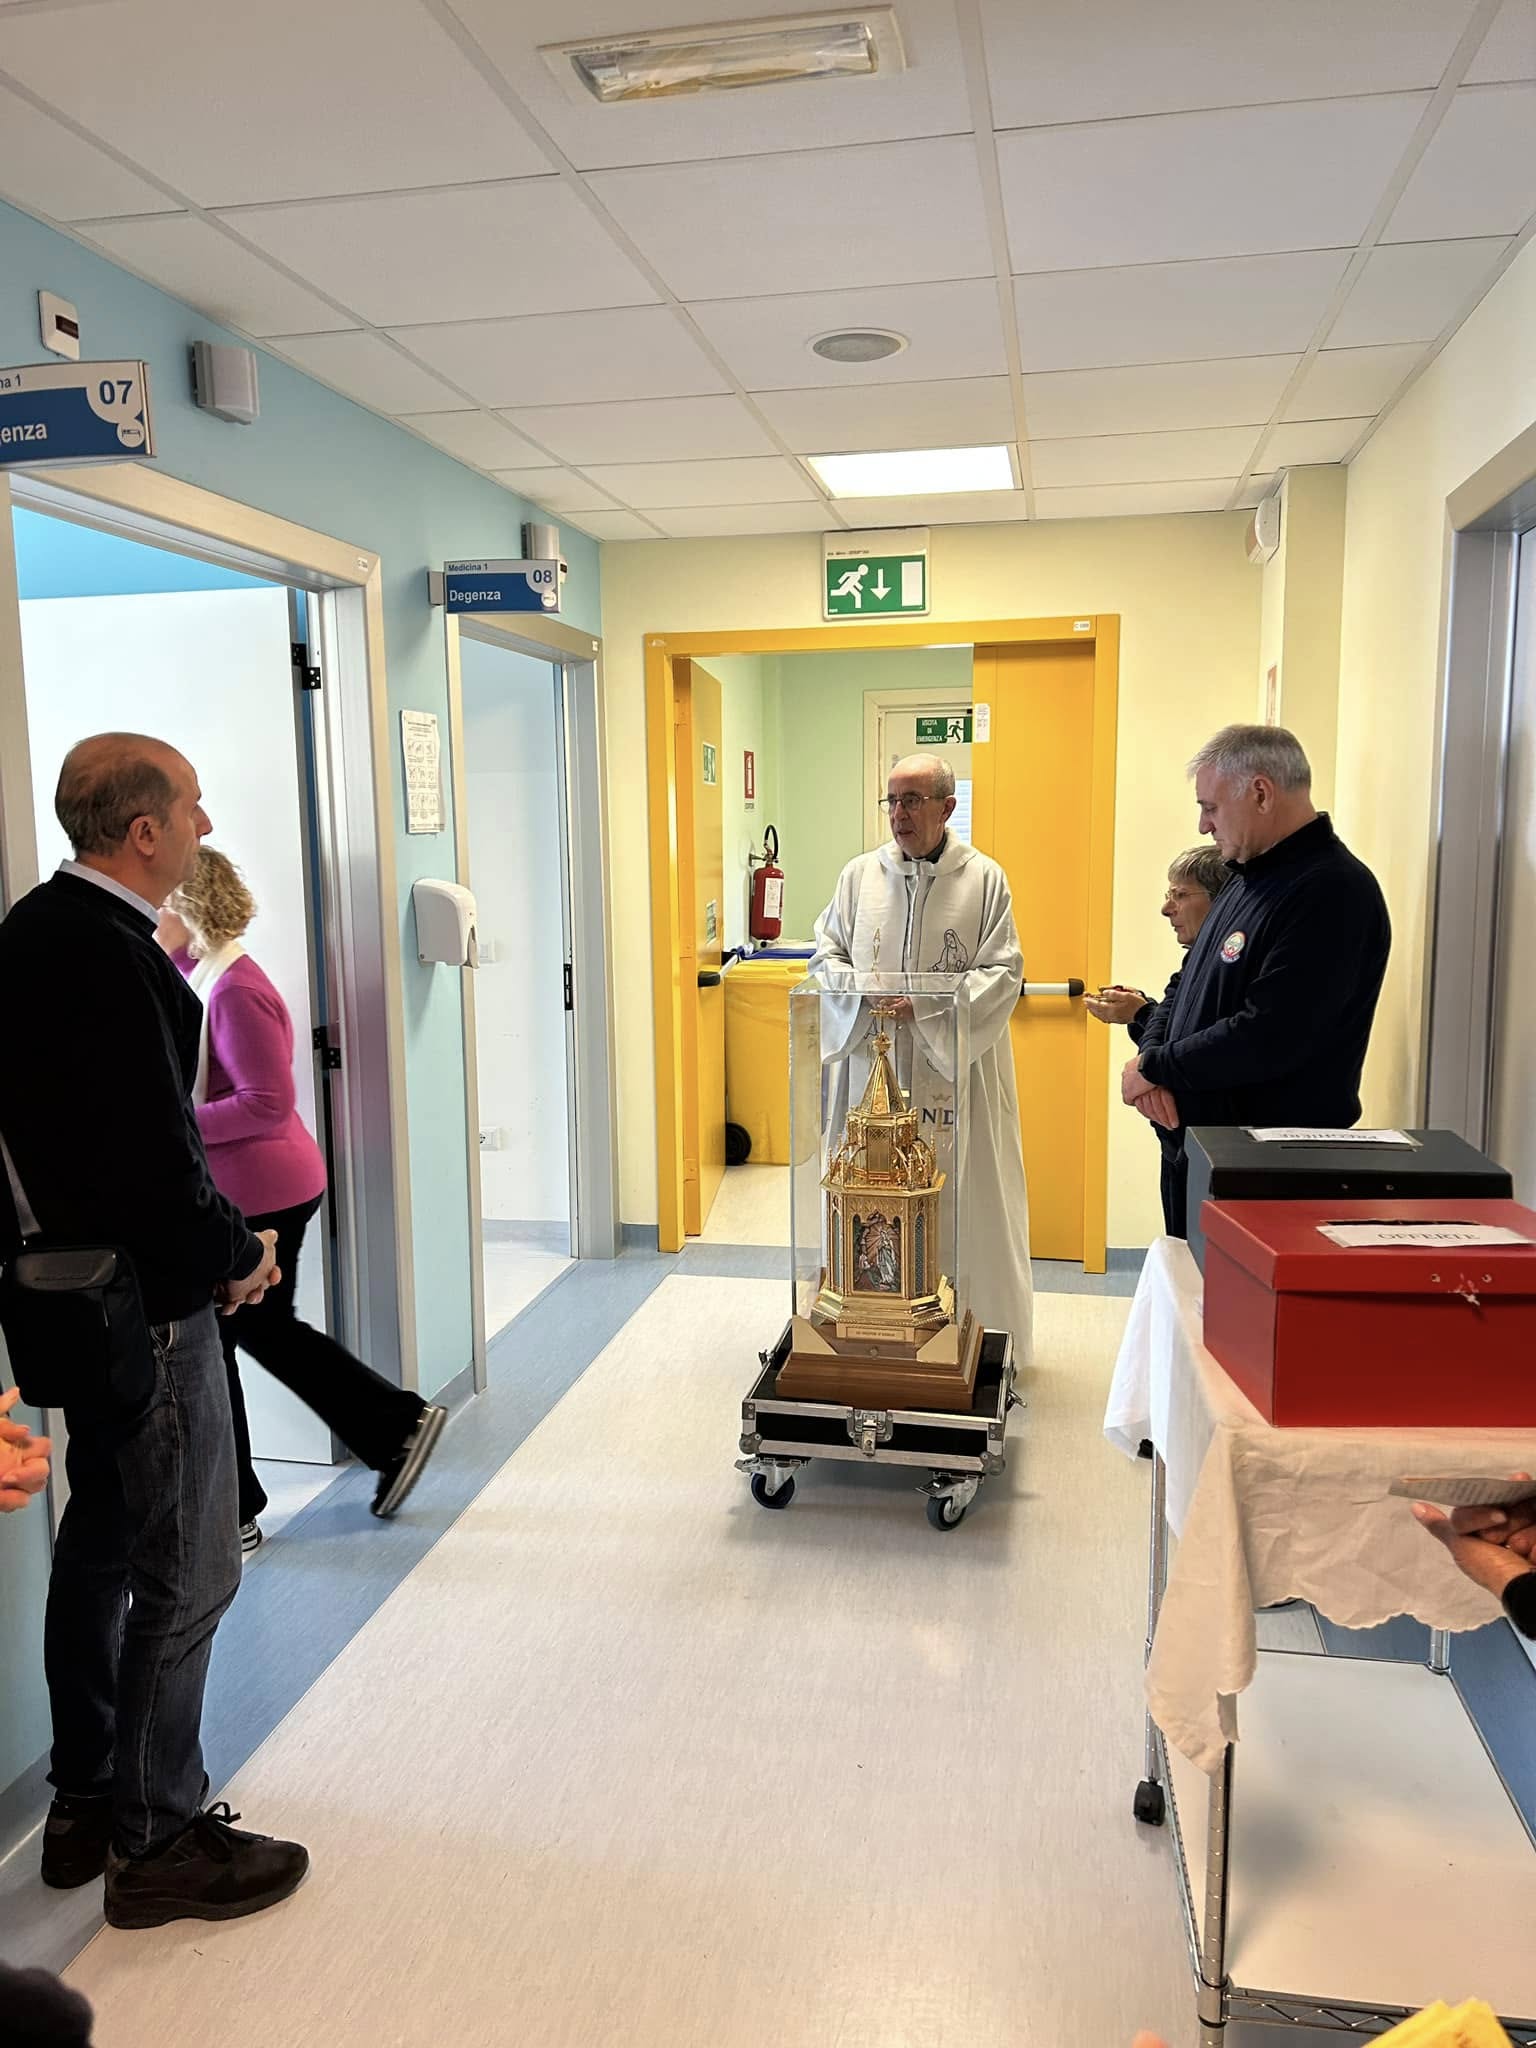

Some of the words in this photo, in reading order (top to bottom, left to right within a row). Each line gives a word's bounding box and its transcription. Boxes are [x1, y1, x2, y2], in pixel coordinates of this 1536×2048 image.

[15, 373, 22, 387] 1
[99, 380, 133, 405] 07
[0, 423, 48, 445] enza
[448, 563, 482, 572] Medicina
[533, 569, 553, 583] 08
[449, 589, 501, 604] Degenza
